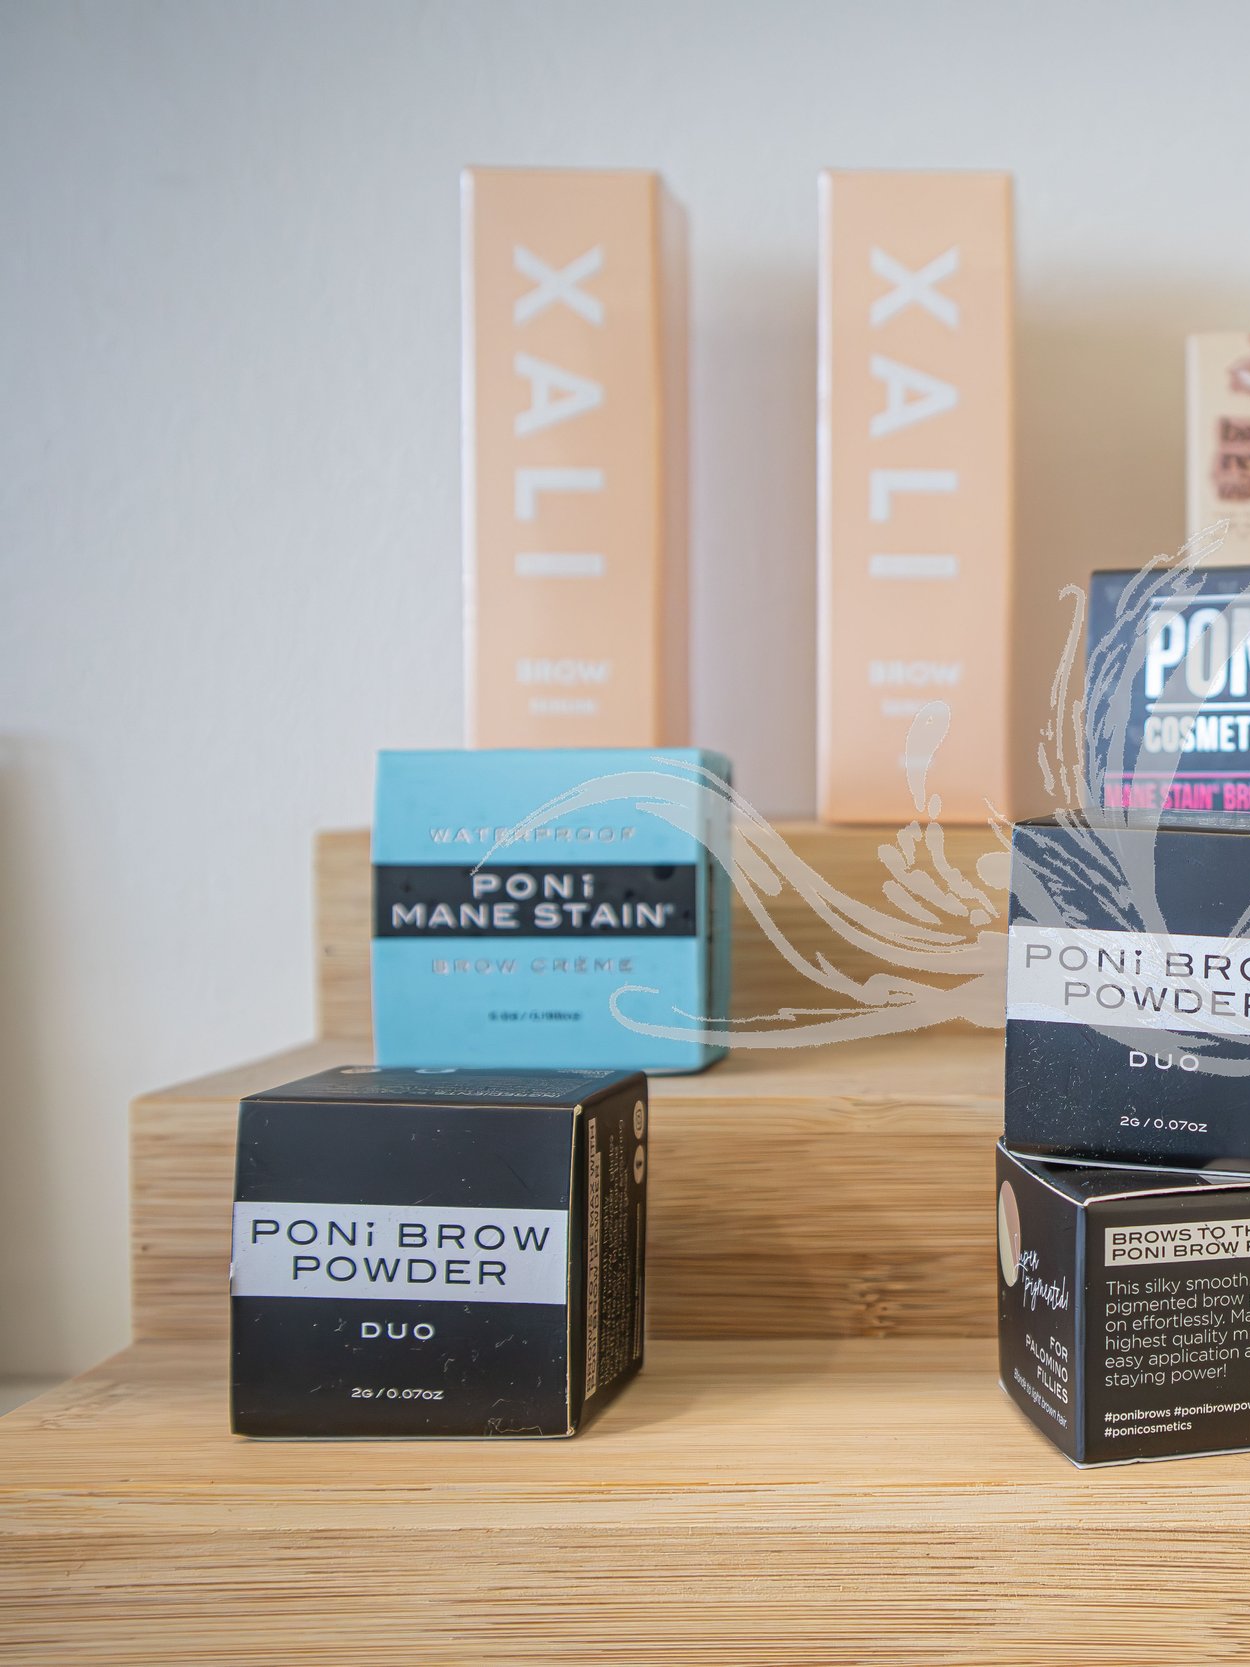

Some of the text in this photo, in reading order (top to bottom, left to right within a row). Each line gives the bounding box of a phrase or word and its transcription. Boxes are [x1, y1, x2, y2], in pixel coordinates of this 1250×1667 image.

[513, 243, 605, 579] XALI
[868, 243, 958, 580] XALI
[429, 827, 636, 844] WATERPROOF
[391, 902, 520, 928] MANE
[432, 955, 634, 975] BROW CRÈME
[1130, 1050, 1199, 1072] DUO
[398, 1222, 550, 1252] BROW
[1112, 1228, 1192, 1246] BROWS
[1198, 1225, 1226, 1240] TO
[1112, 1246, 1166, 1261] PONI
[1173, 1241, 1240, 1258] BROW
[291, 1255, 507, 1286] POWDER
[1106, 1281, 1140, 1295] This
[1145, 1278, 1181, 1295] silky
[1105, 1296, 1197, 1316] pigmented
[1203, 1293, 1244, 1308] brow
[361, 1321, 436, 1341] DUO
[1105, 1320, 1127, 1332] on
[1132, 1311, 1226, 1331] effortlessly.
[1050, 1336, 1068, 1363] FOR
[1105, 1333, 1167, 1352] highest
[1172, 1328, 1228, 1347] quality
[1025, 1333, 1069, 1383] PALOMINO
[1105, 1353, 1143, 1370] easy
[1148, 1345, 1240, 1367] application
[1036, 1365, 1069, 1404] FILLIES
[1105, 1363, 1227, 1388] staying power!
[1104, 1408, 1171, 1424] #ponibrows
[1104, 1420, 1192, 1438] #ponicosmetics
